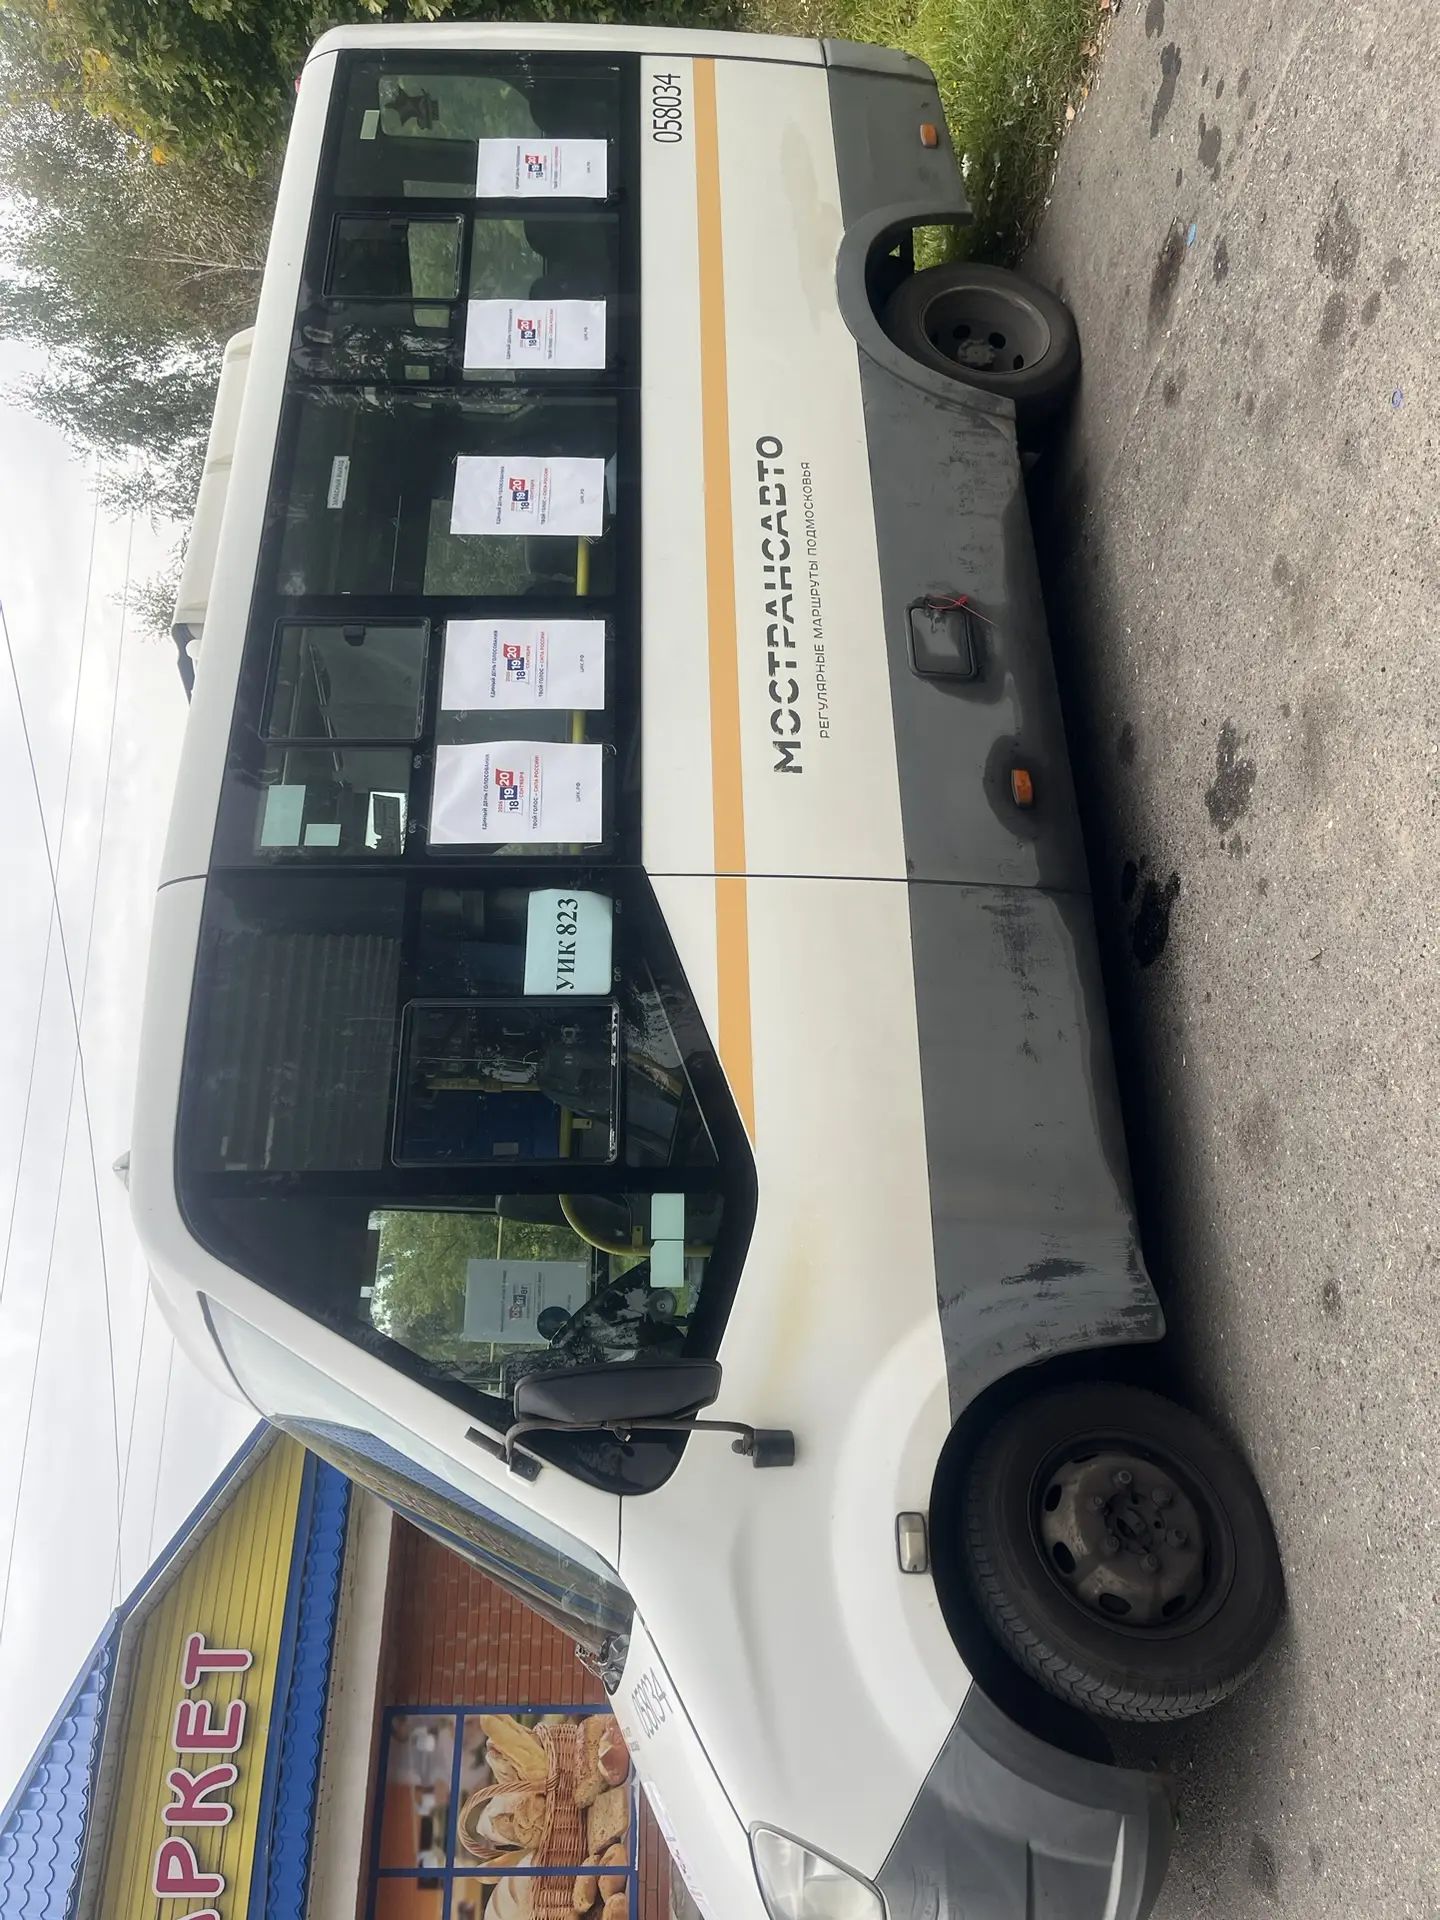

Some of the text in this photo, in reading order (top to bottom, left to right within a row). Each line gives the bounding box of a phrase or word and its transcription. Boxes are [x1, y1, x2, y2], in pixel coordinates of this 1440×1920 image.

[653, 74, 682, 143] 058034
[521, 321, 529, 329] 20
[513, 480, 530, 510] 18 19 20
[755, 435, 803, 774] МОСТРАНСАВТО
[800, 461, 831, 739] РЕГУЛЯРНЫЕ МАРШРУТЫ ПОДМОСКОВЬЯ
[507, 646, 526, 680] 18 19 20
[500, 772, 519, 811] 18 19 20
[556, 898, 578, 991] УИК 823
[632, 1667, 673, 1739] 058034
